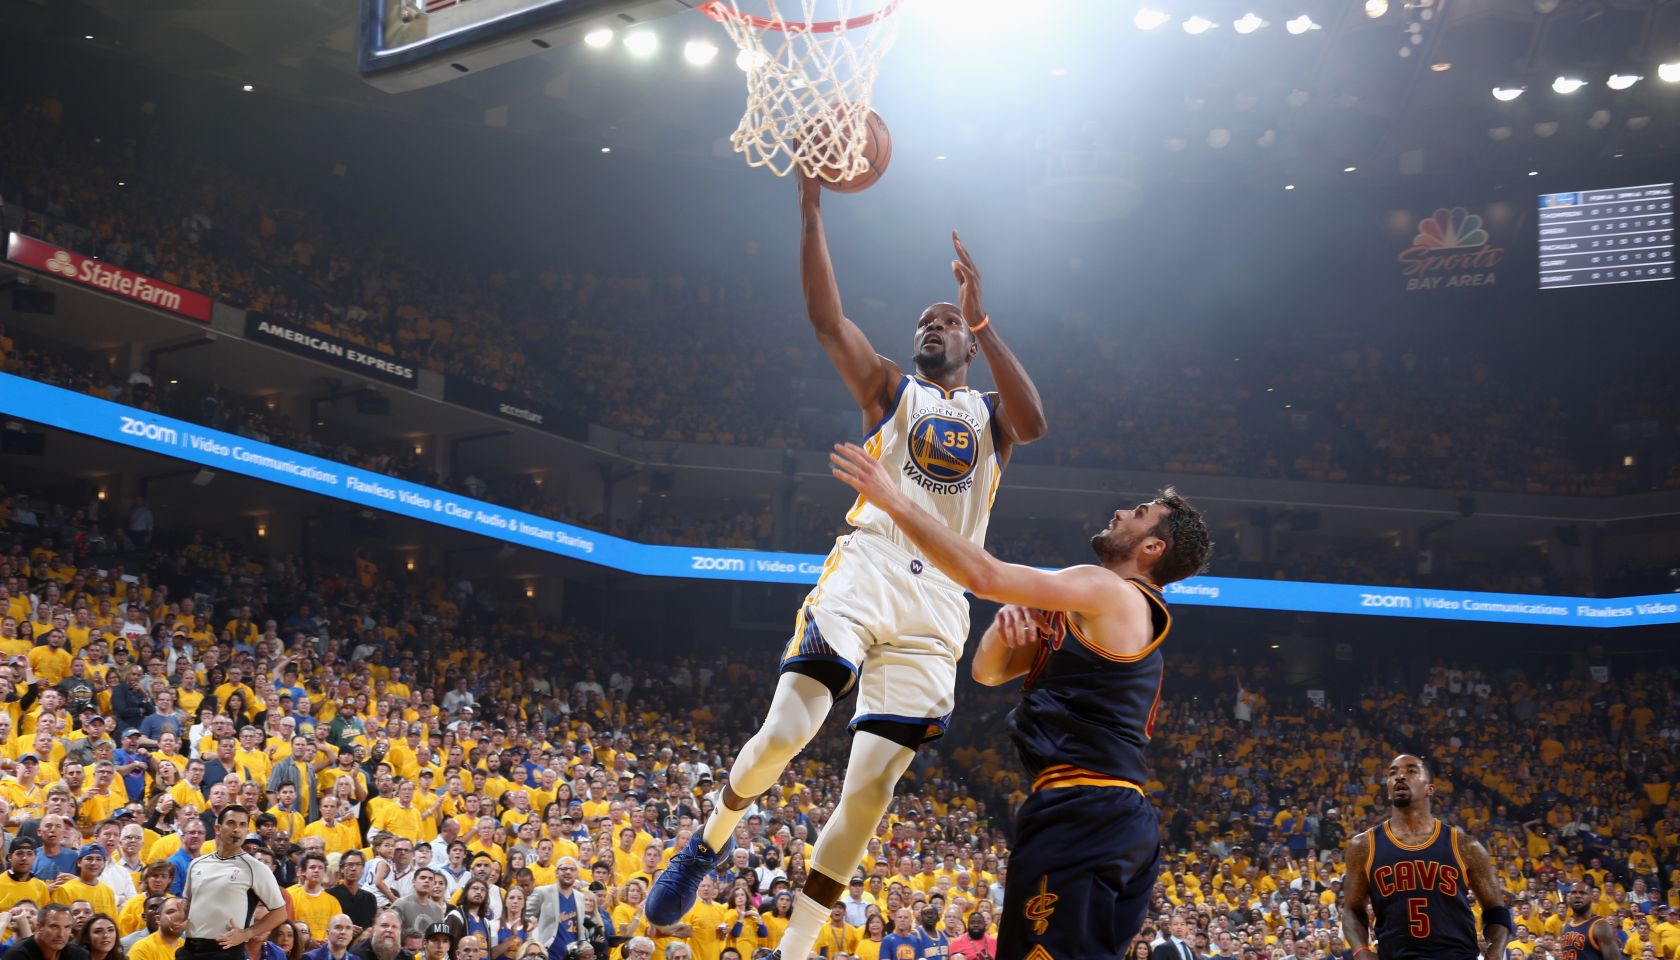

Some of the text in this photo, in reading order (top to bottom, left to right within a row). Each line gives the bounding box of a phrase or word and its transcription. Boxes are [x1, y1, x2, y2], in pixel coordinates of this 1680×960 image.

[1406, 273, 1496, 291] BAY AREA
[258, 321, 413, 378] AMERICAN EXPRESS
[912, 407, 983, 436] GOLDEN STATE
[943, 431, 969, 449] 35
[120, 416, 594, 553] zoom Video Communications Flawless Video & Clear Audio & Instant Sharing
[903, 461, 973, 495] WARRIORS
[691, 556, 744, 571] zoom
[757, 560, 795, 573] Video
[1169, 582, 1219, 598] Sharing
[1360, 593, 1412, 608] zoom
[1423, 597, 1459, 610] Video
[1462, 599, 1568, 616] Communications
[1577, 605, 1632, 617] Flawless
[1636, 603, 1677, 615] Video
[1374, 860, 1459, 897] CAVS
[1408, 897, 1430, 939] 5
